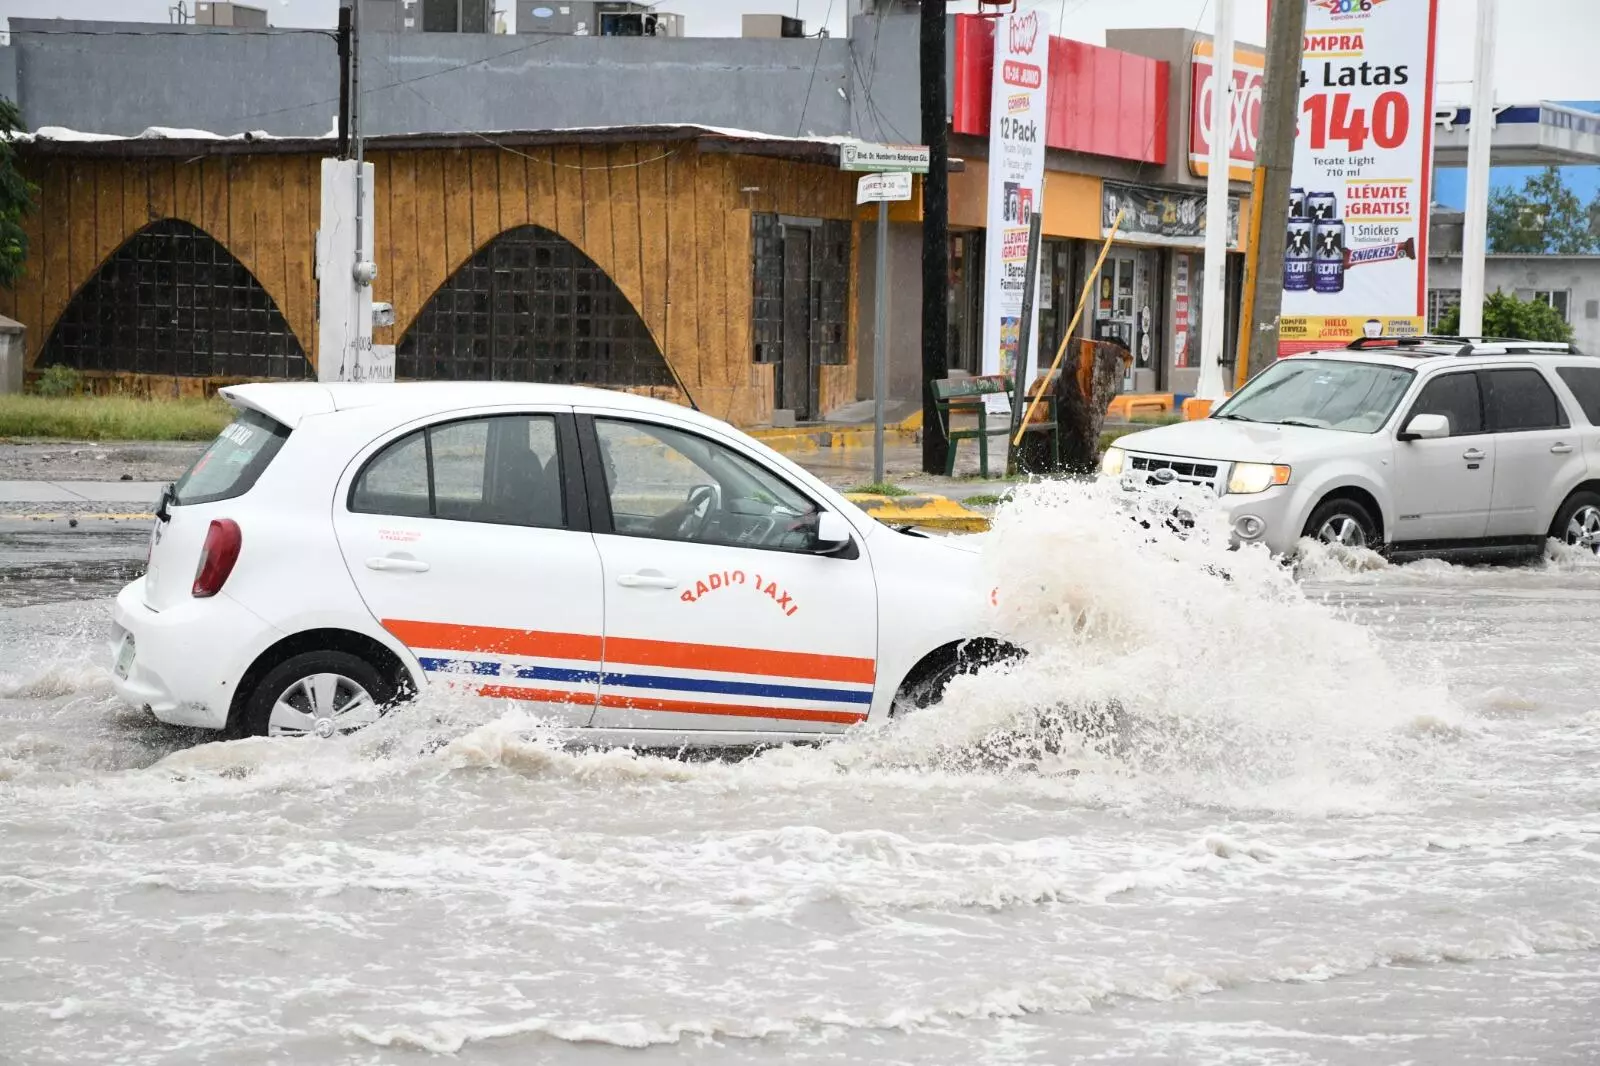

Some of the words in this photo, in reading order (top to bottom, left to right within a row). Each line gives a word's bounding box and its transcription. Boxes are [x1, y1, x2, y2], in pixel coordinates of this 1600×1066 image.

[1323, 61, 1408, 87] Latas
[1000, 117, 1009, 139] 12
[1012, 118, 1037, 143] Pack
[1314, 157, 1344, 165] Tecate
[1349, 156, 1375, 166] Light
[1326, 169, 1343, 177] 710
[1347, 168, 1360, 176] ml
[1347, 184, 1407, 199] LLÉVATE
[1345, 202, 1410, 217] ¡GRATIS!
[1351, 226, 1355, 235] 1
[1358, 224, 1399, 236] Snickers
[1350, 245, 1397, 262] SNICKERS
[1000, 278, 1025, 290] Familiare
[680, 570, 745, 602] RADIO
[755, 574, 798, 616] TAXI
